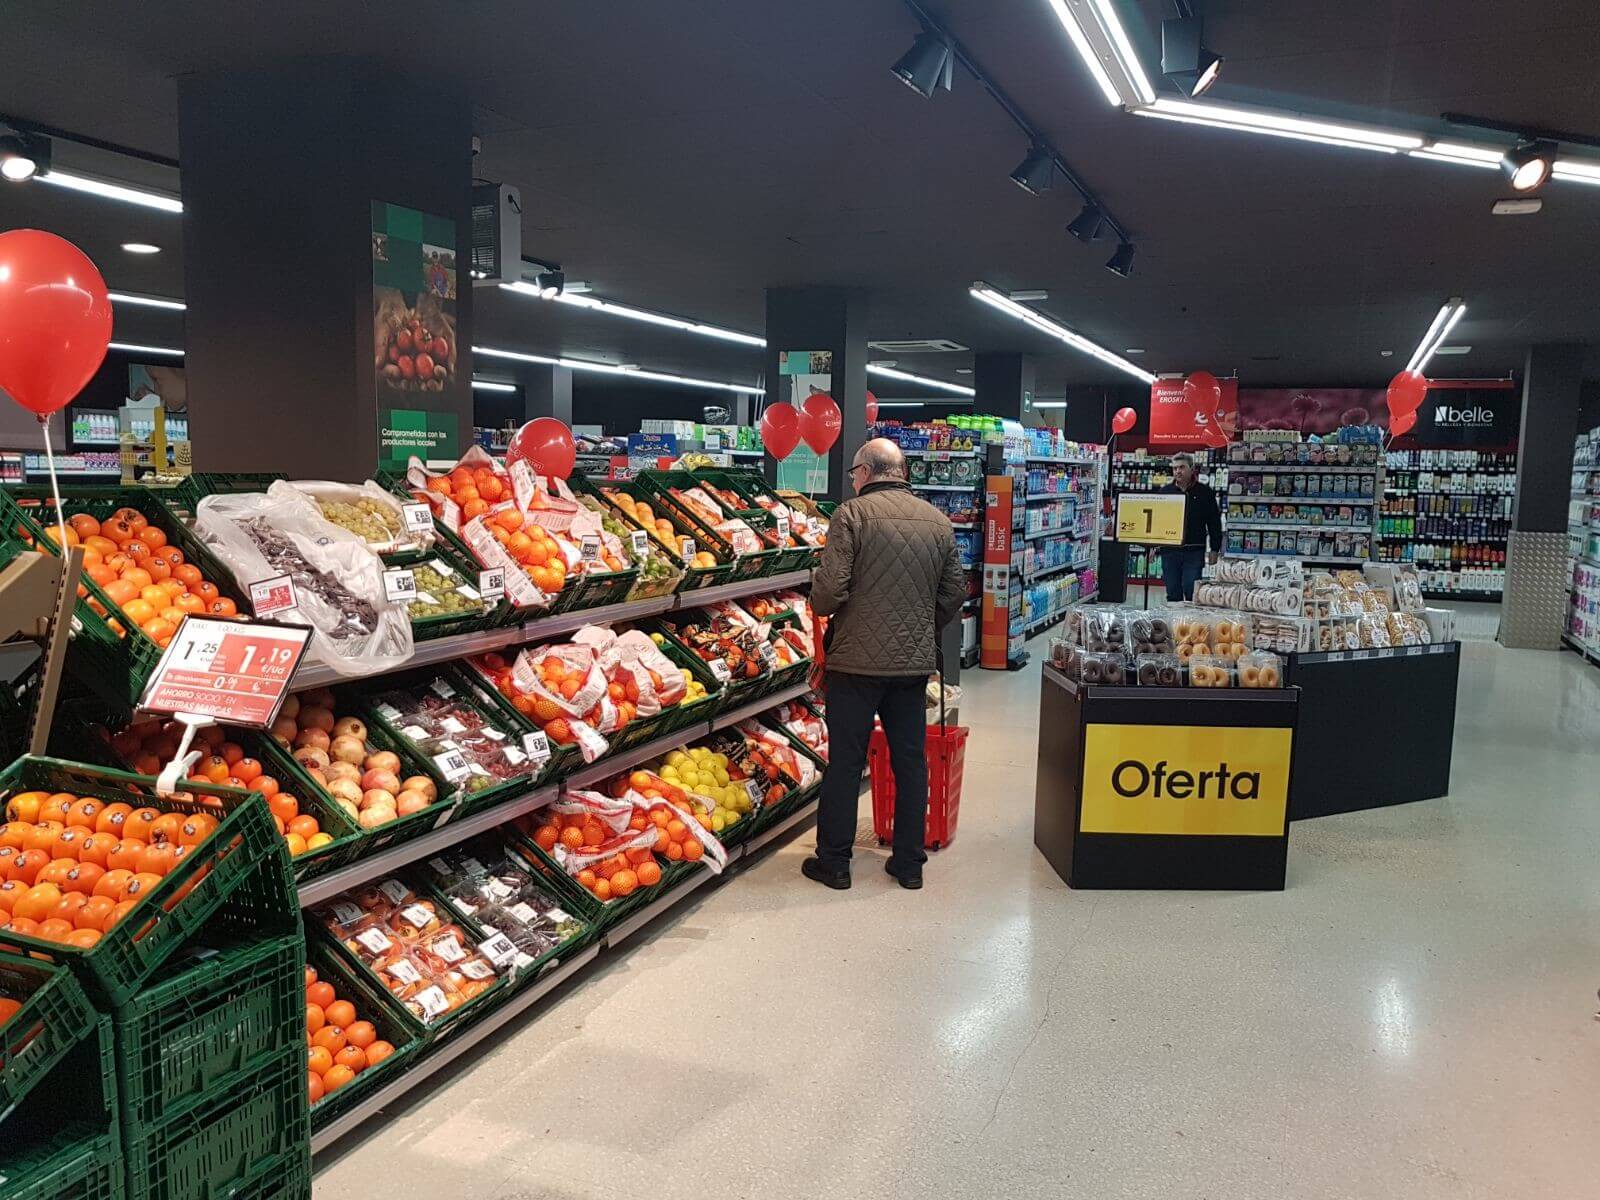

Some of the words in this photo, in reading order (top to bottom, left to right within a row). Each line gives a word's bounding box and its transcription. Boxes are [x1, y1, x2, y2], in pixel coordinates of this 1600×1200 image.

[1448, 406, 1494, 422] belle
[381, 428, 427, 438] Comprometidos
[381, 439, 417, 447] productores
[417, 439, 437, 447] locales
[1143, 508, 1153, 534] 1
[995, 526, 1006, 551] basic
[160, 688, 194, 699] AHORRO
[157, 698, 195, 710] NUESTRAS
[195, 703, 232, 714] MARCAS
[1112, 760, 1260, 800] Oferta
